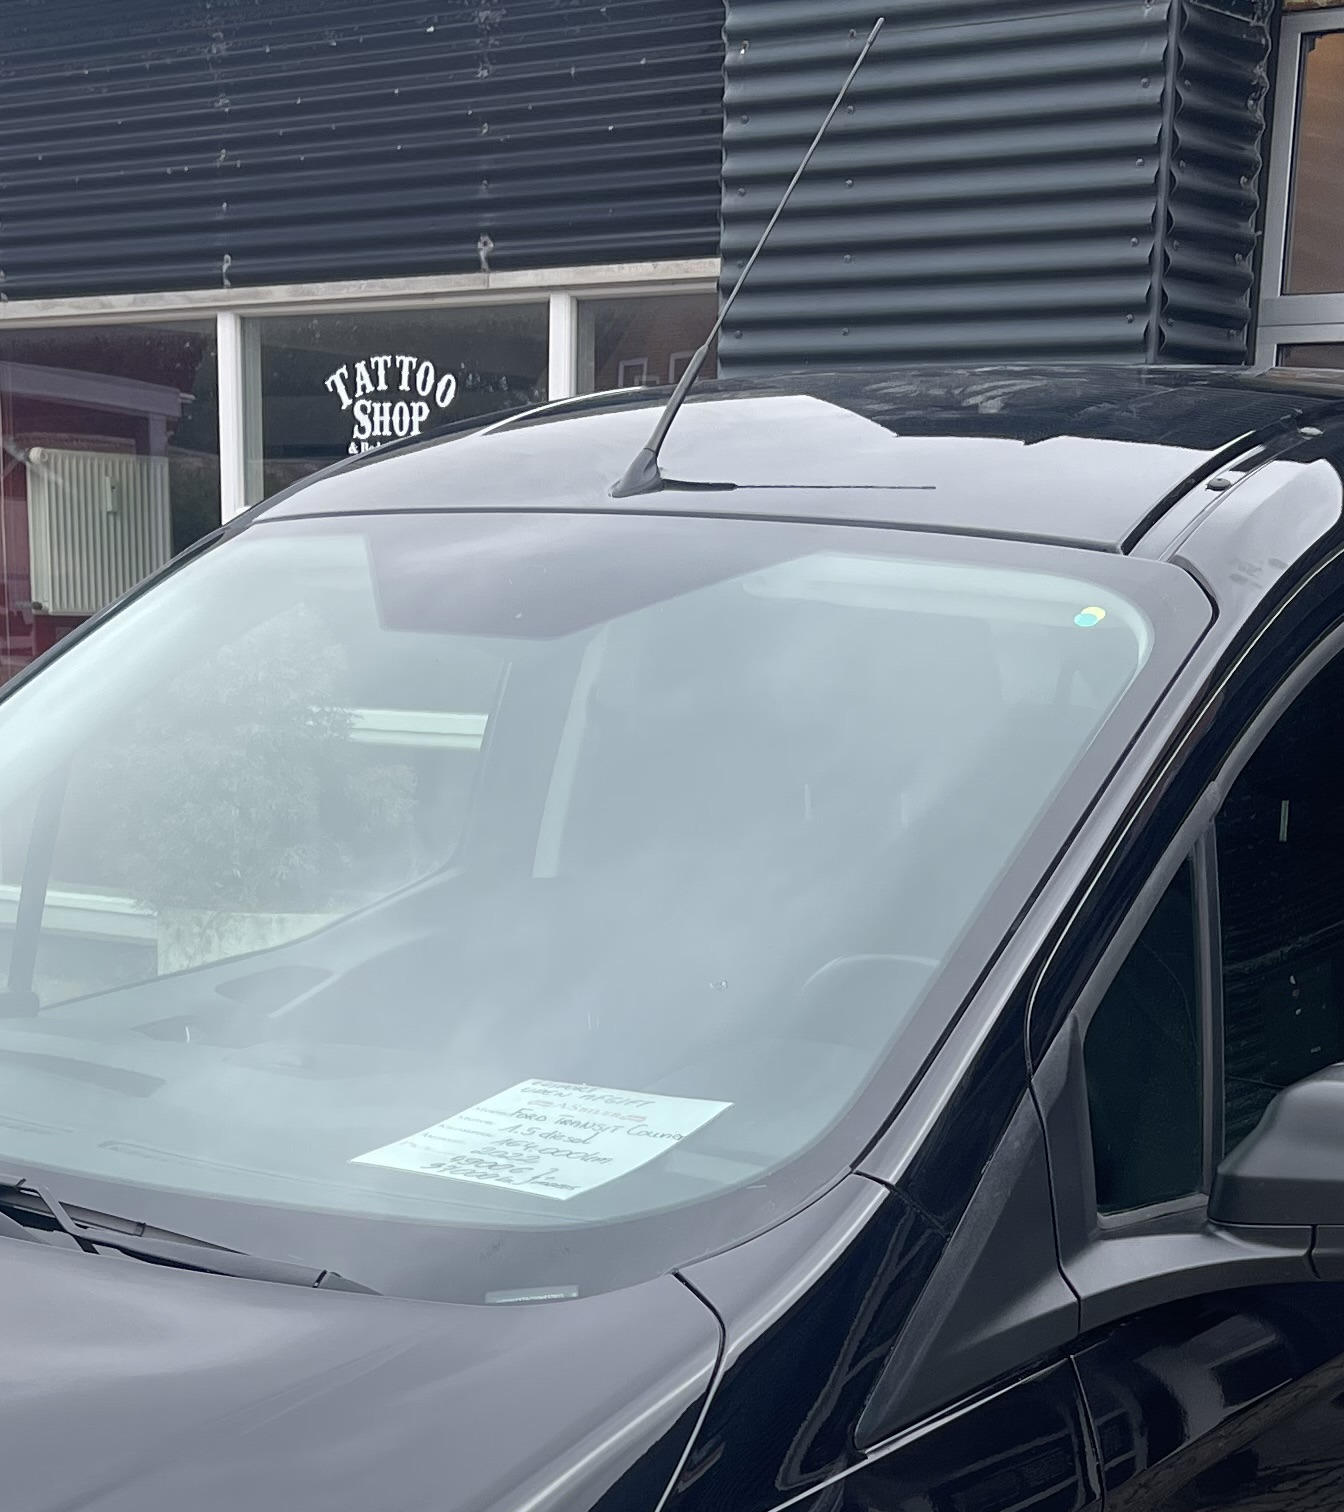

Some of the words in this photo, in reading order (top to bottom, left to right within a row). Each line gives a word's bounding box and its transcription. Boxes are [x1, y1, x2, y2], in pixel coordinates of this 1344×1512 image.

[324, 355, 456, 410] TATTOO
[352, 399, 430, 439] SHOP
[348, 441, 359, 454] &
